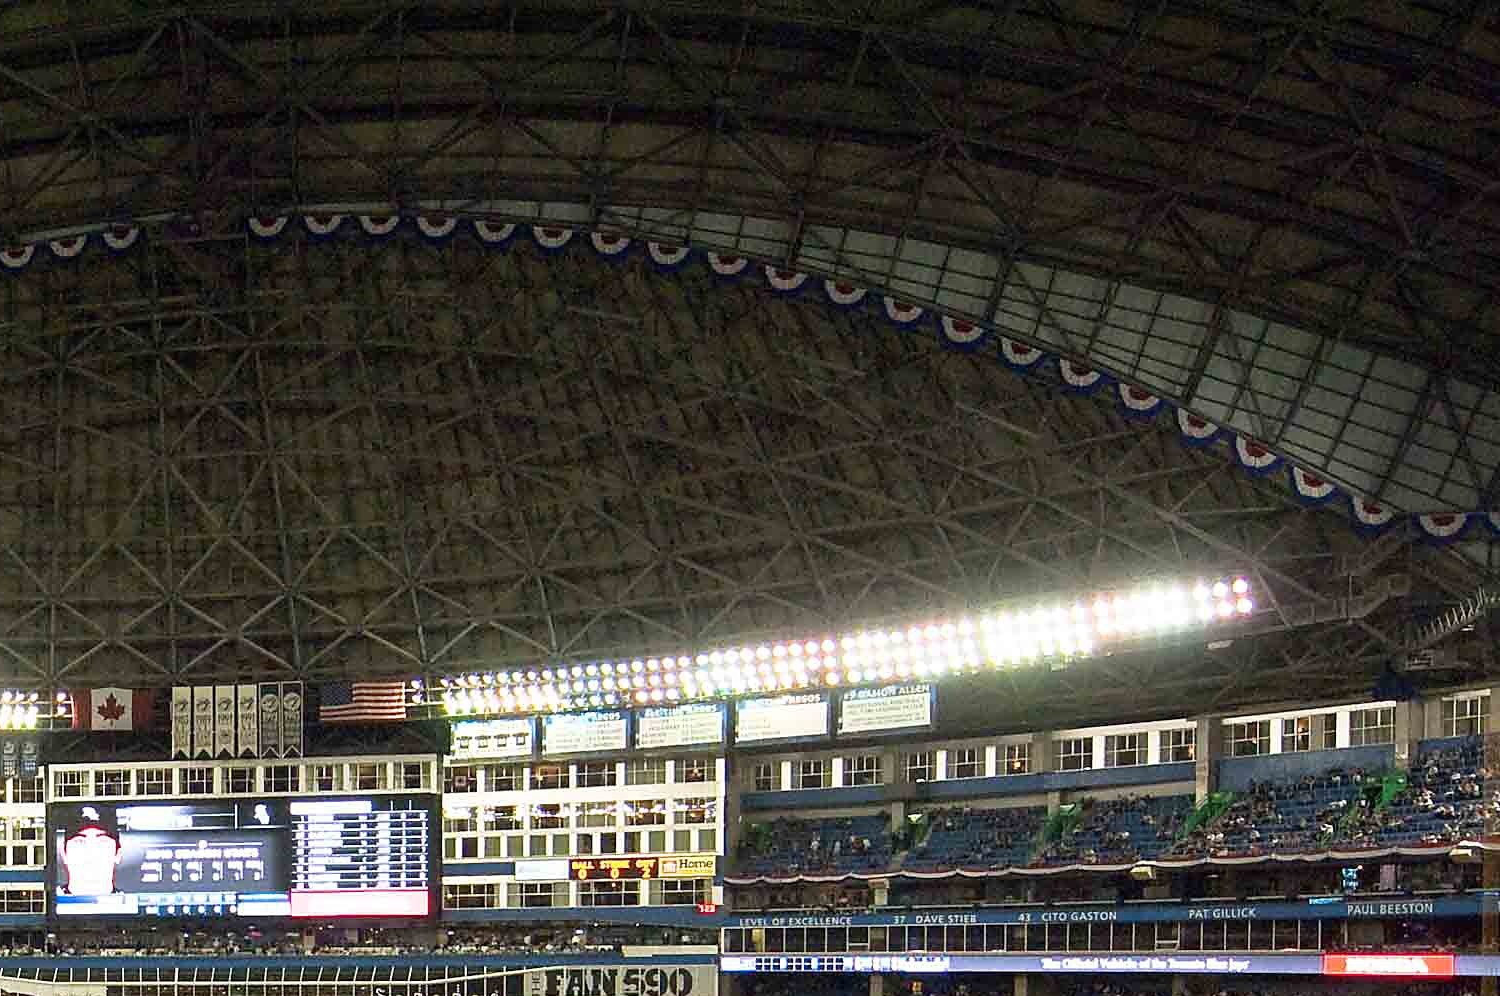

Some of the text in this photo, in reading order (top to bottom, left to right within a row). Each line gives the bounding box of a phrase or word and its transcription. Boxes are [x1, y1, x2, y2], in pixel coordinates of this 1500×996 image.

[679, 859, 713, 869] Home
[1189, 907, 1256, 919] PAT GILLICK
[1347, 903, 1433, 915] PAUL BEESTON
[740, 916, 852, 926] LEVEL OF EXCELLENCE
[915, 914, 946, 924] DAVE
[948, 914, 977, 923] STIEB
[1041, 912, 1066, 921] CITO
[1069, 911, 1116, 921] GASTON
[545, 968, 617, 996] FAN
[622, 968, 693, 996] 590
